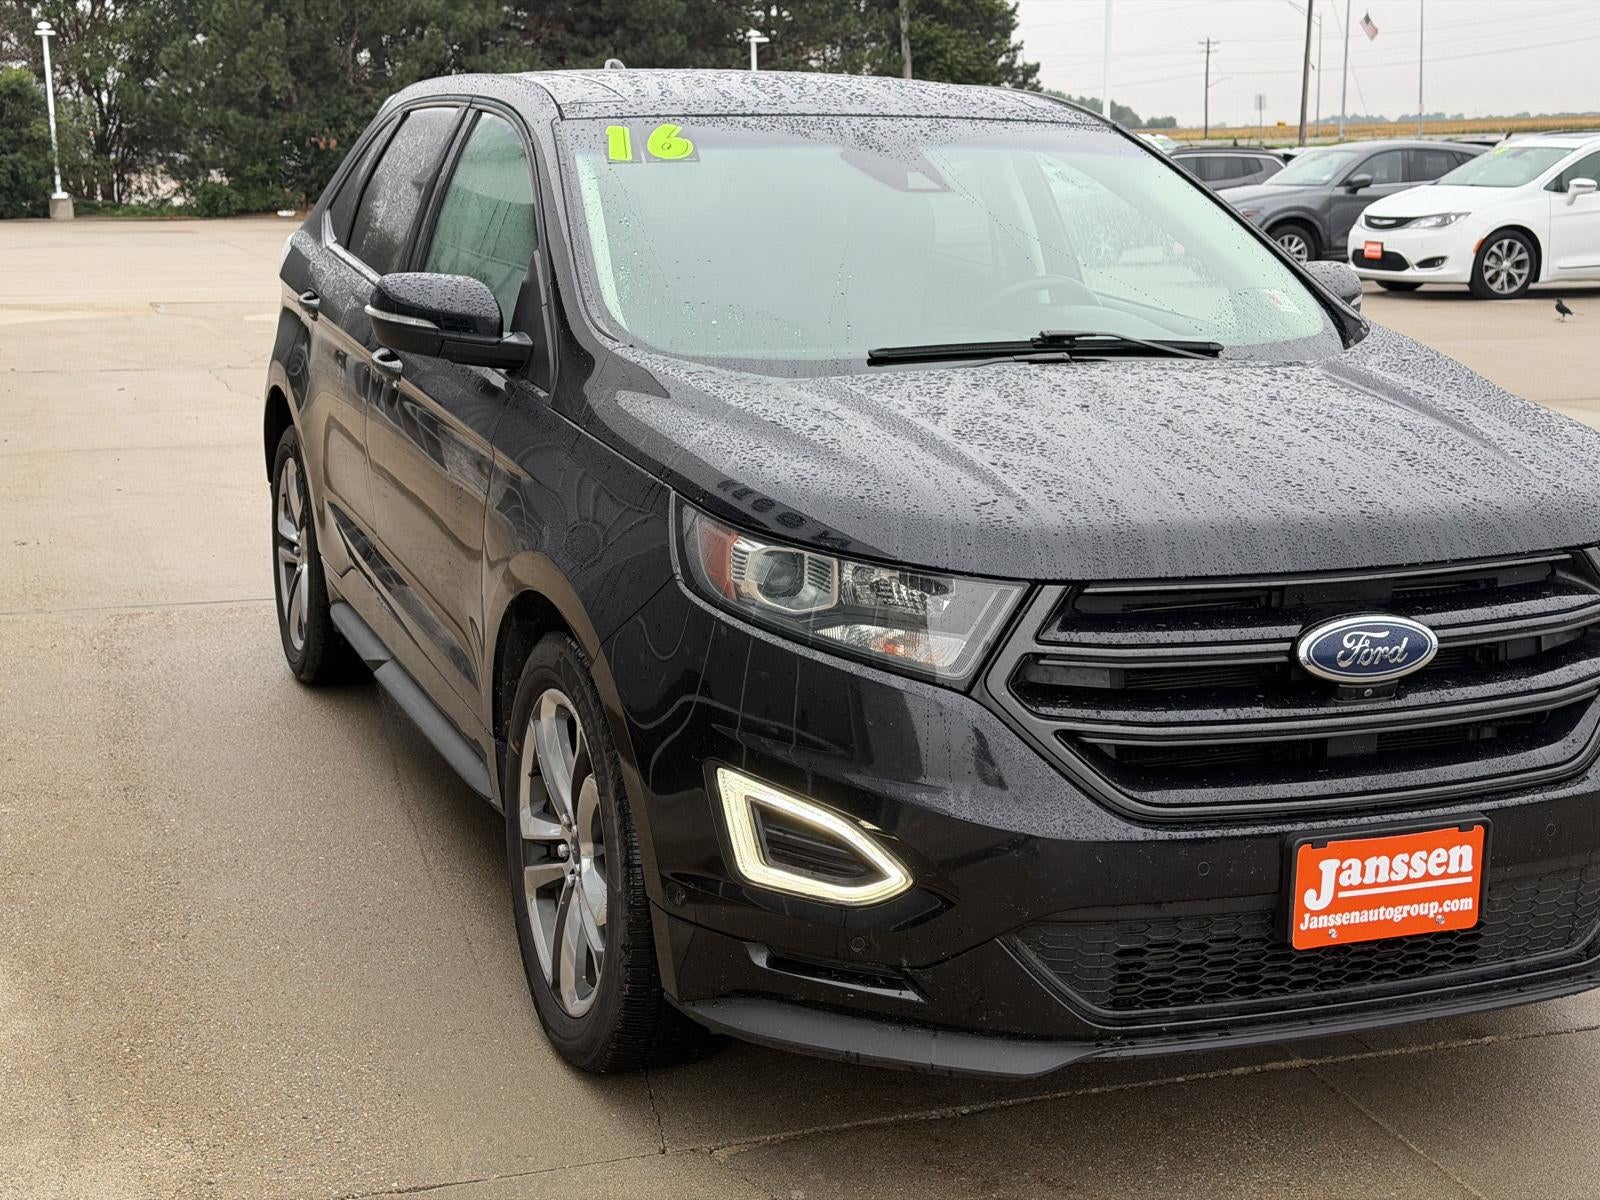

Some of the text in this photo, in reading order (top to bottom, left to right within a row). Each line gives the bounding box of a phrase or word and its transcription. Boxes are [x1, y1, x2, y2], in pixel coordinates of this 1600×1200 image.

[605, 124, 693, 160] 16
[1336, 631, 1409, 668] Ford
[1303, 844, 1473, 911] Janssen
[1300, 897, 1473, 931] Janssenautogroup.com
